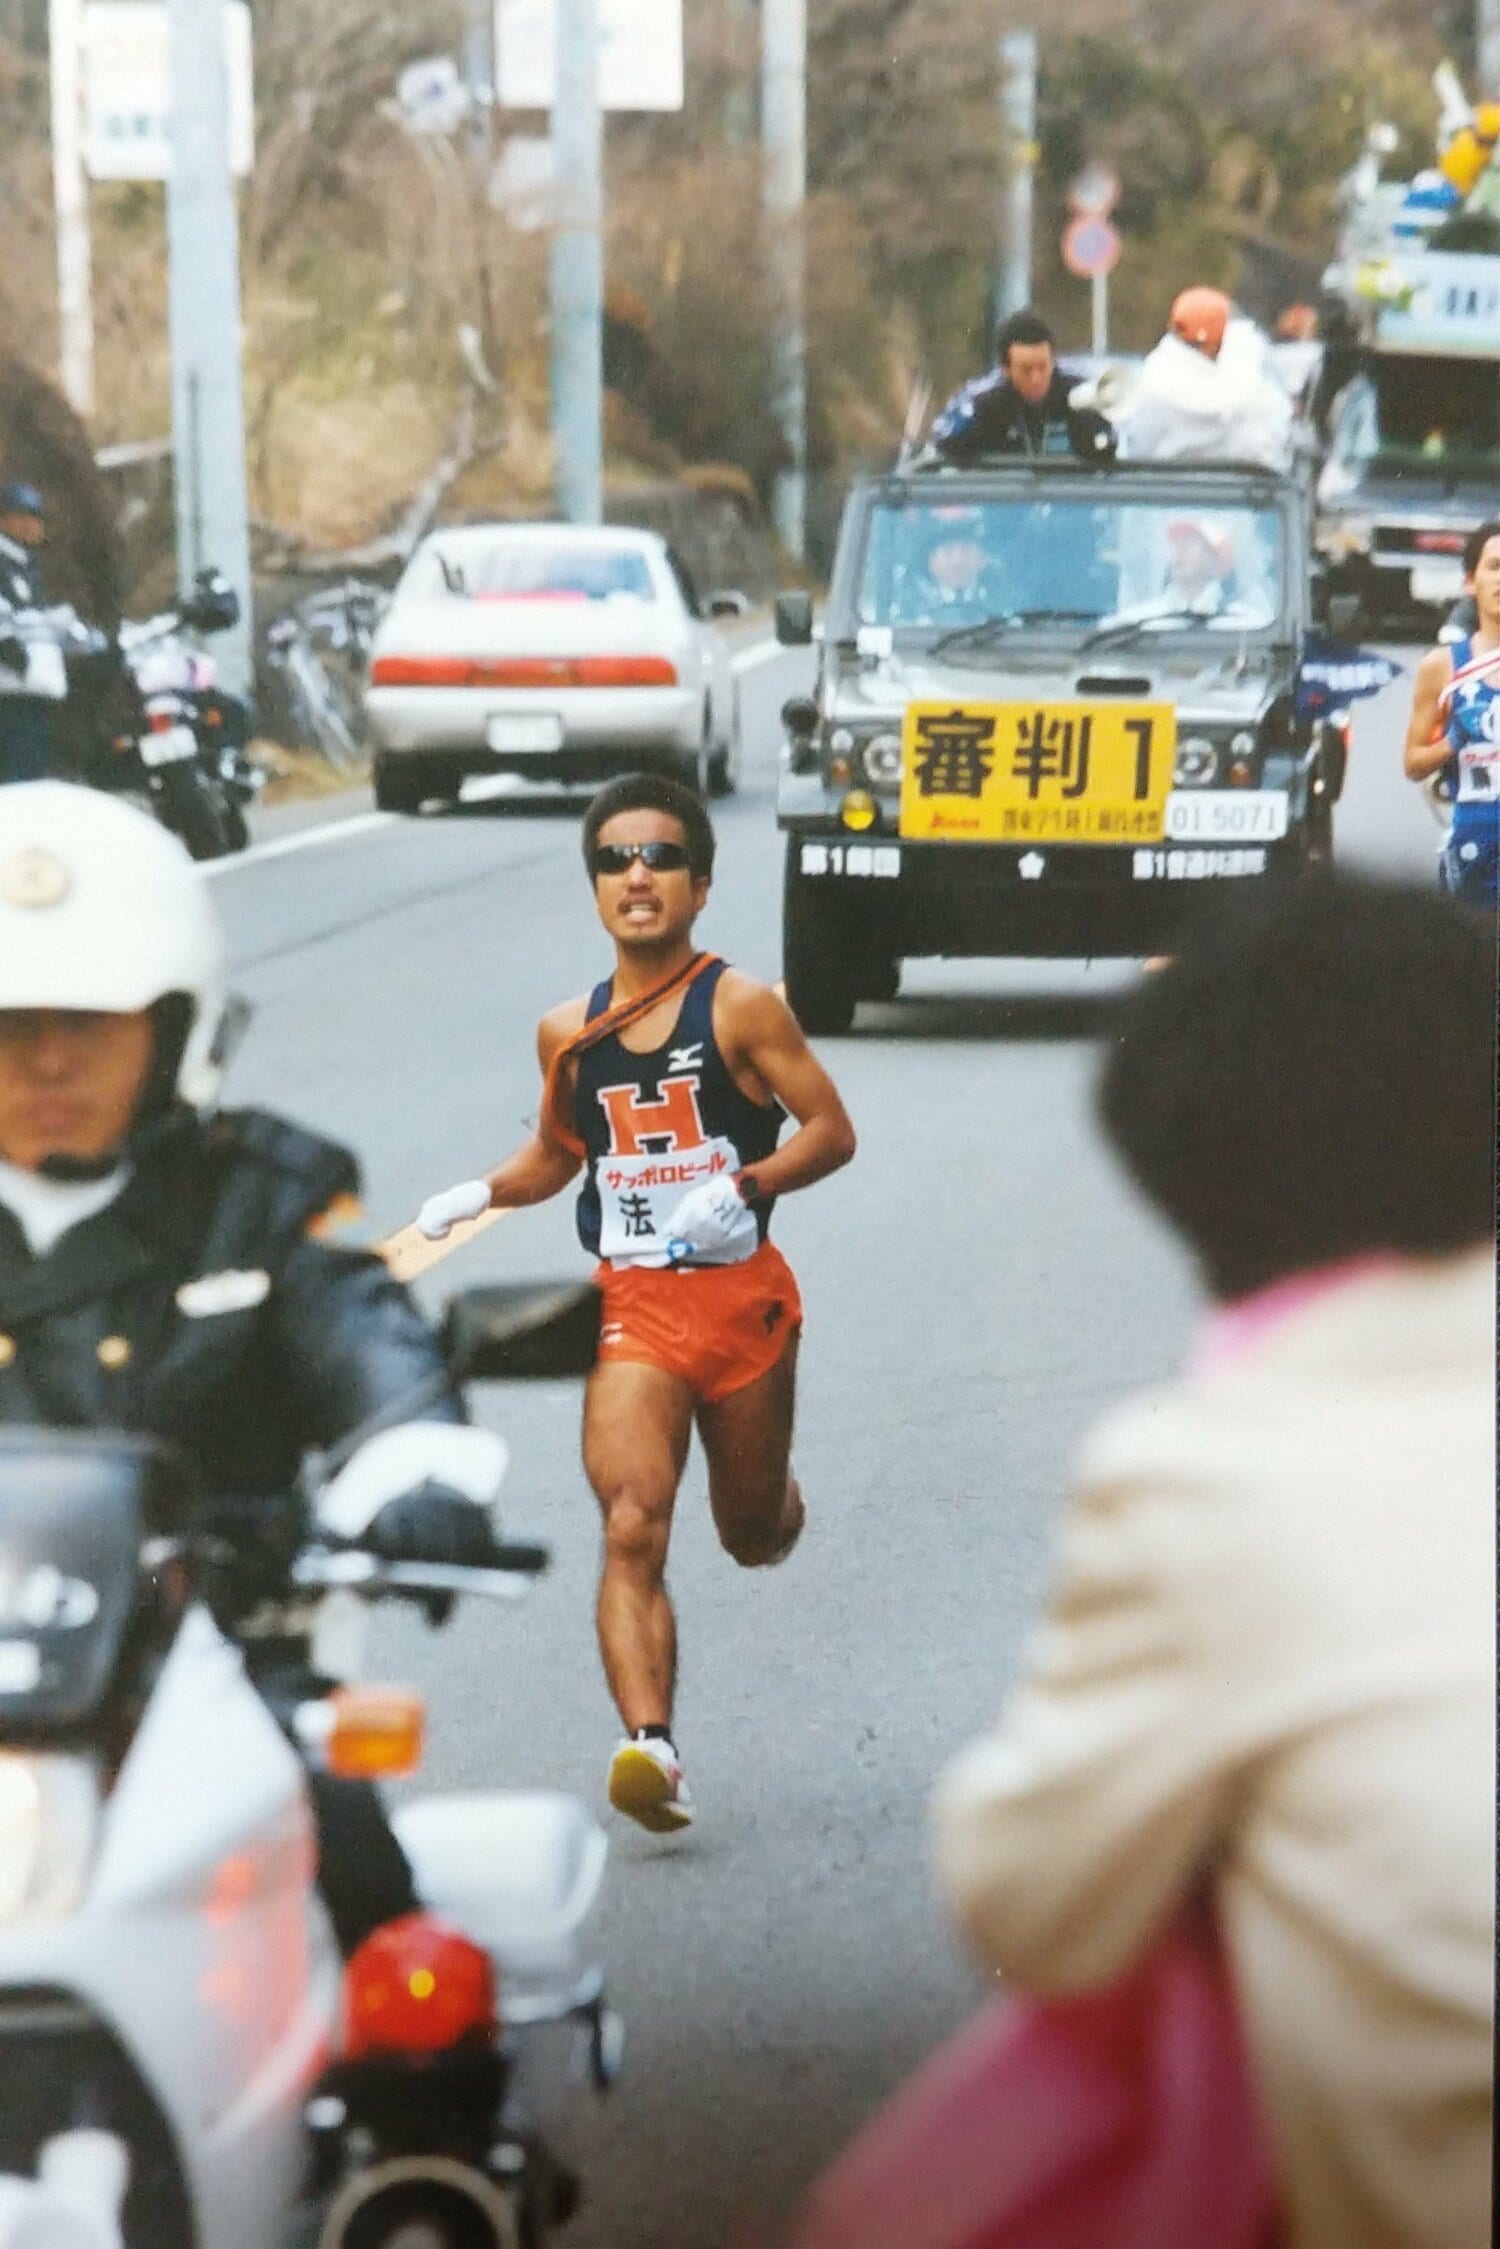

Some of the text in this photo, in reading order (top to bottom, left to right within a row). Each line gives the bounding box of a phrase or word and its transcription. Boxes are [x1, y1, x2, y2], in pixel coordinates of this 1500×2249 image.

[1173, 805, 1200, 831] 01
[1213, 804, 1276, 831] 5071
[597, 1074, 710, 1158] H
[606, 1151, 728, 1190] サッポロビール
[618, 1193, 656, 1237] 法
